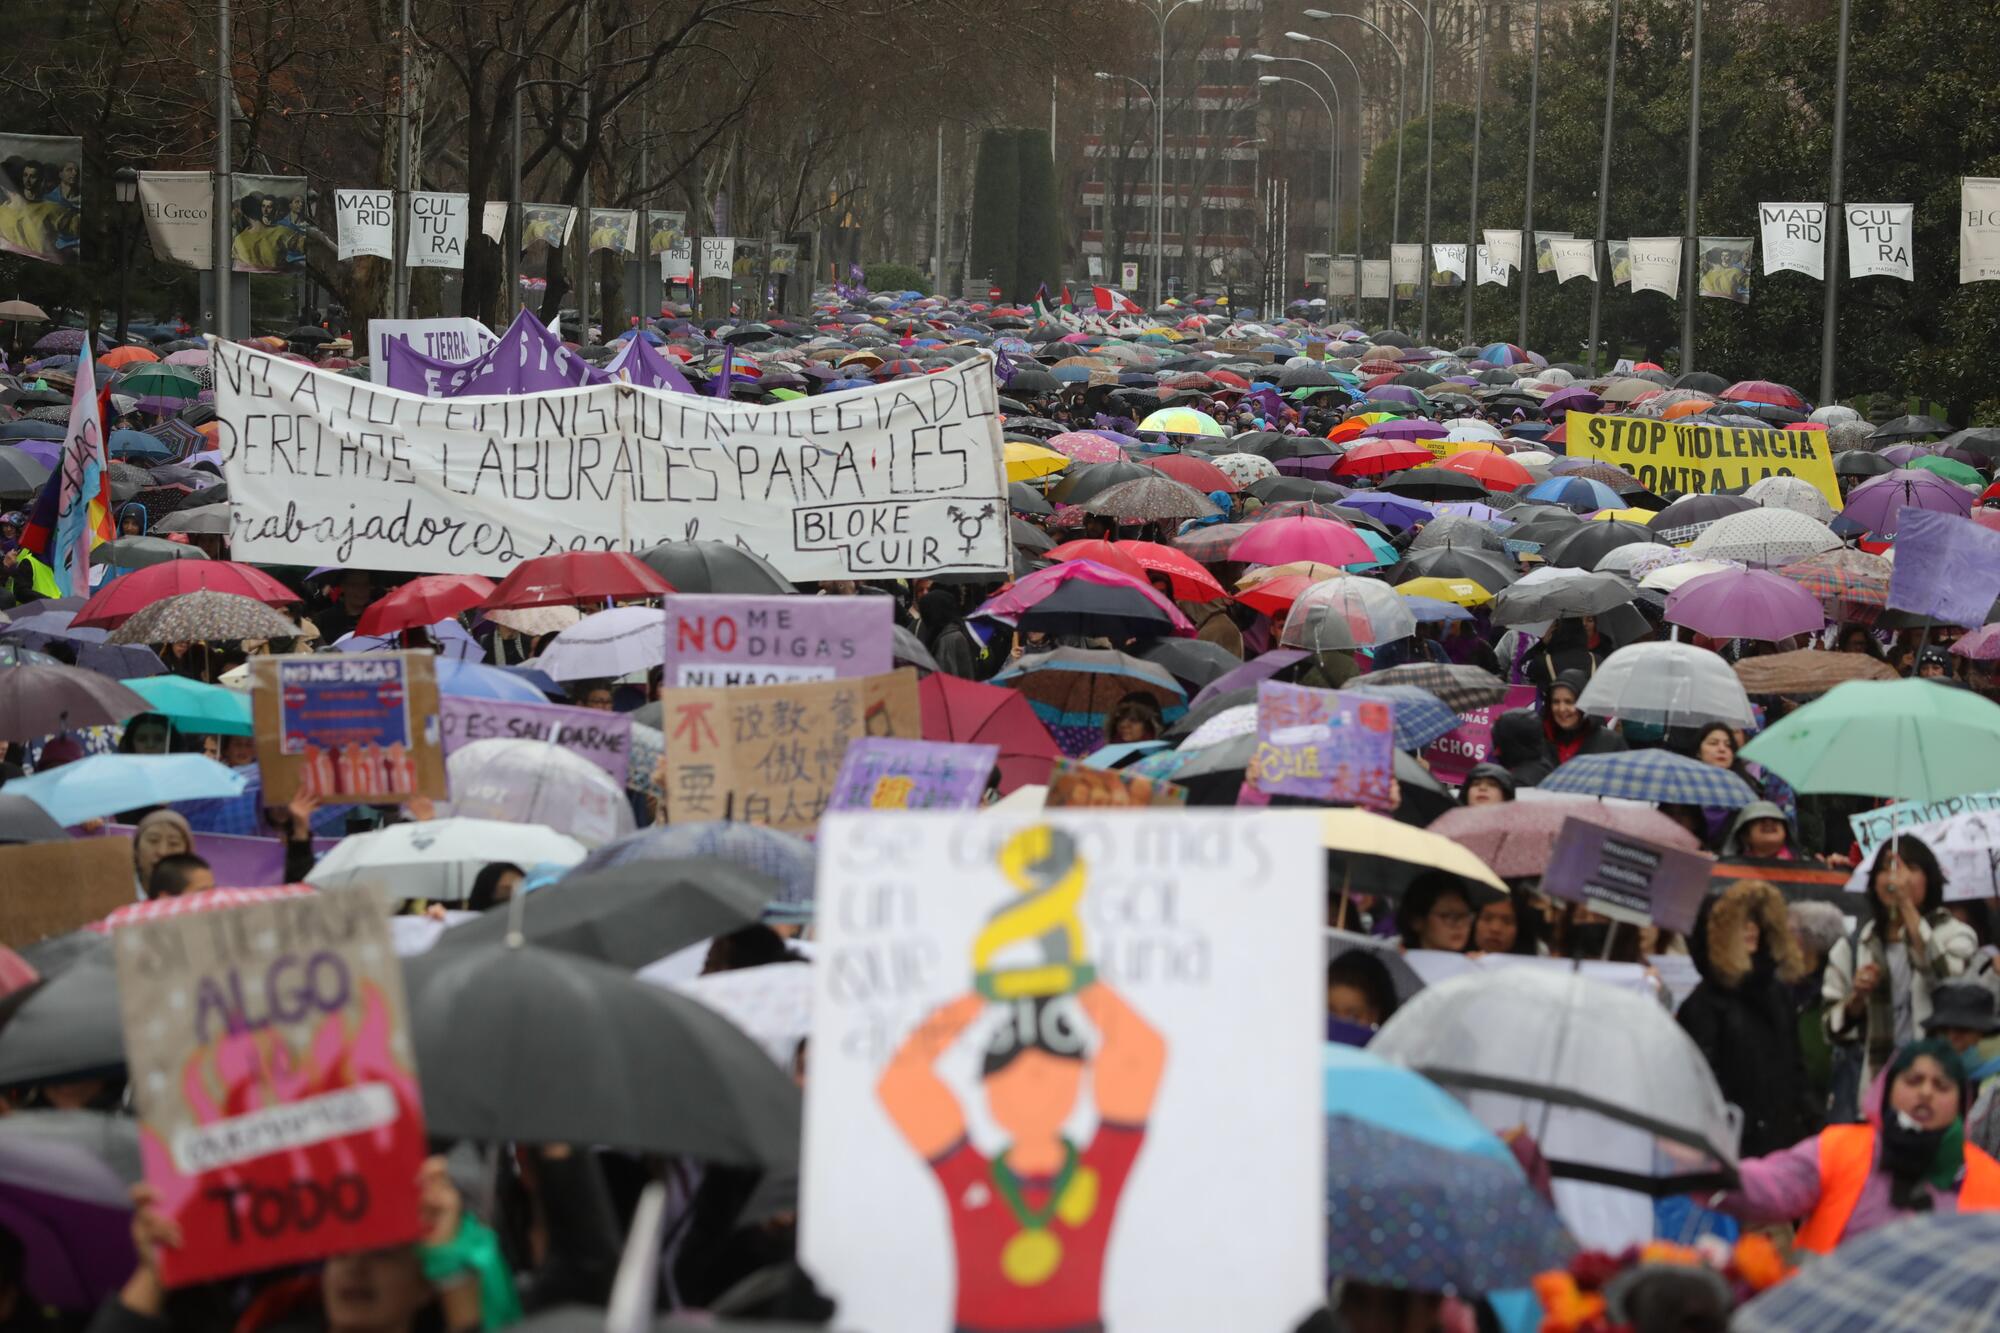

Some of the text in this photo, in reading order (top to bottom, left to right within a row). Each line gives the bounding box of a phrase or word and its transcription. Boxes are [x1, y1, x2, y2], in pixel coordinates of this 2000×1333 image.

[146, 202, 208, 219] El Greco
[338, 194, 391, 211] MAD
[413, 197, 456, 216] CUL
[357, 209, 391, 227] RID
[418, 216, 448, 235] TU
[1762, 208, 1823, 226] MAD
[1850, 209, 1902, 227] CUL
[1967, 209, 1984, 227] El
[1786, 223, 1822, 244] RID
[1858, 226, 1894, 244] TU
[431, 235, 461, 256] RA
[671, 249, 690, 260] RID
[702, 240, 728, 250] CUL
[707, 249, 723, 260] TU
[1878, 244, 1910, 268] RA
[713, 260, 730, 272] RA
[1490, 265, 1507, 279] RA
[213, 341, 273, 398] NO
[290, 370, 320, 413] A
[1588, 417, 1817, 461] STOP VIOLENCIA
[736, 441, 866, 503] PARA
[803, 504, 911, 542] BLOKE
[855, 535, 940, 566] CUIR
[747, 609, 792, 630] ME
[676, 614, 738, 654] NO
[747, 635, 857, 659] DIGAS
[466, 714, 498, 739] ES
[194, 949, 350, 1046] ALGO
